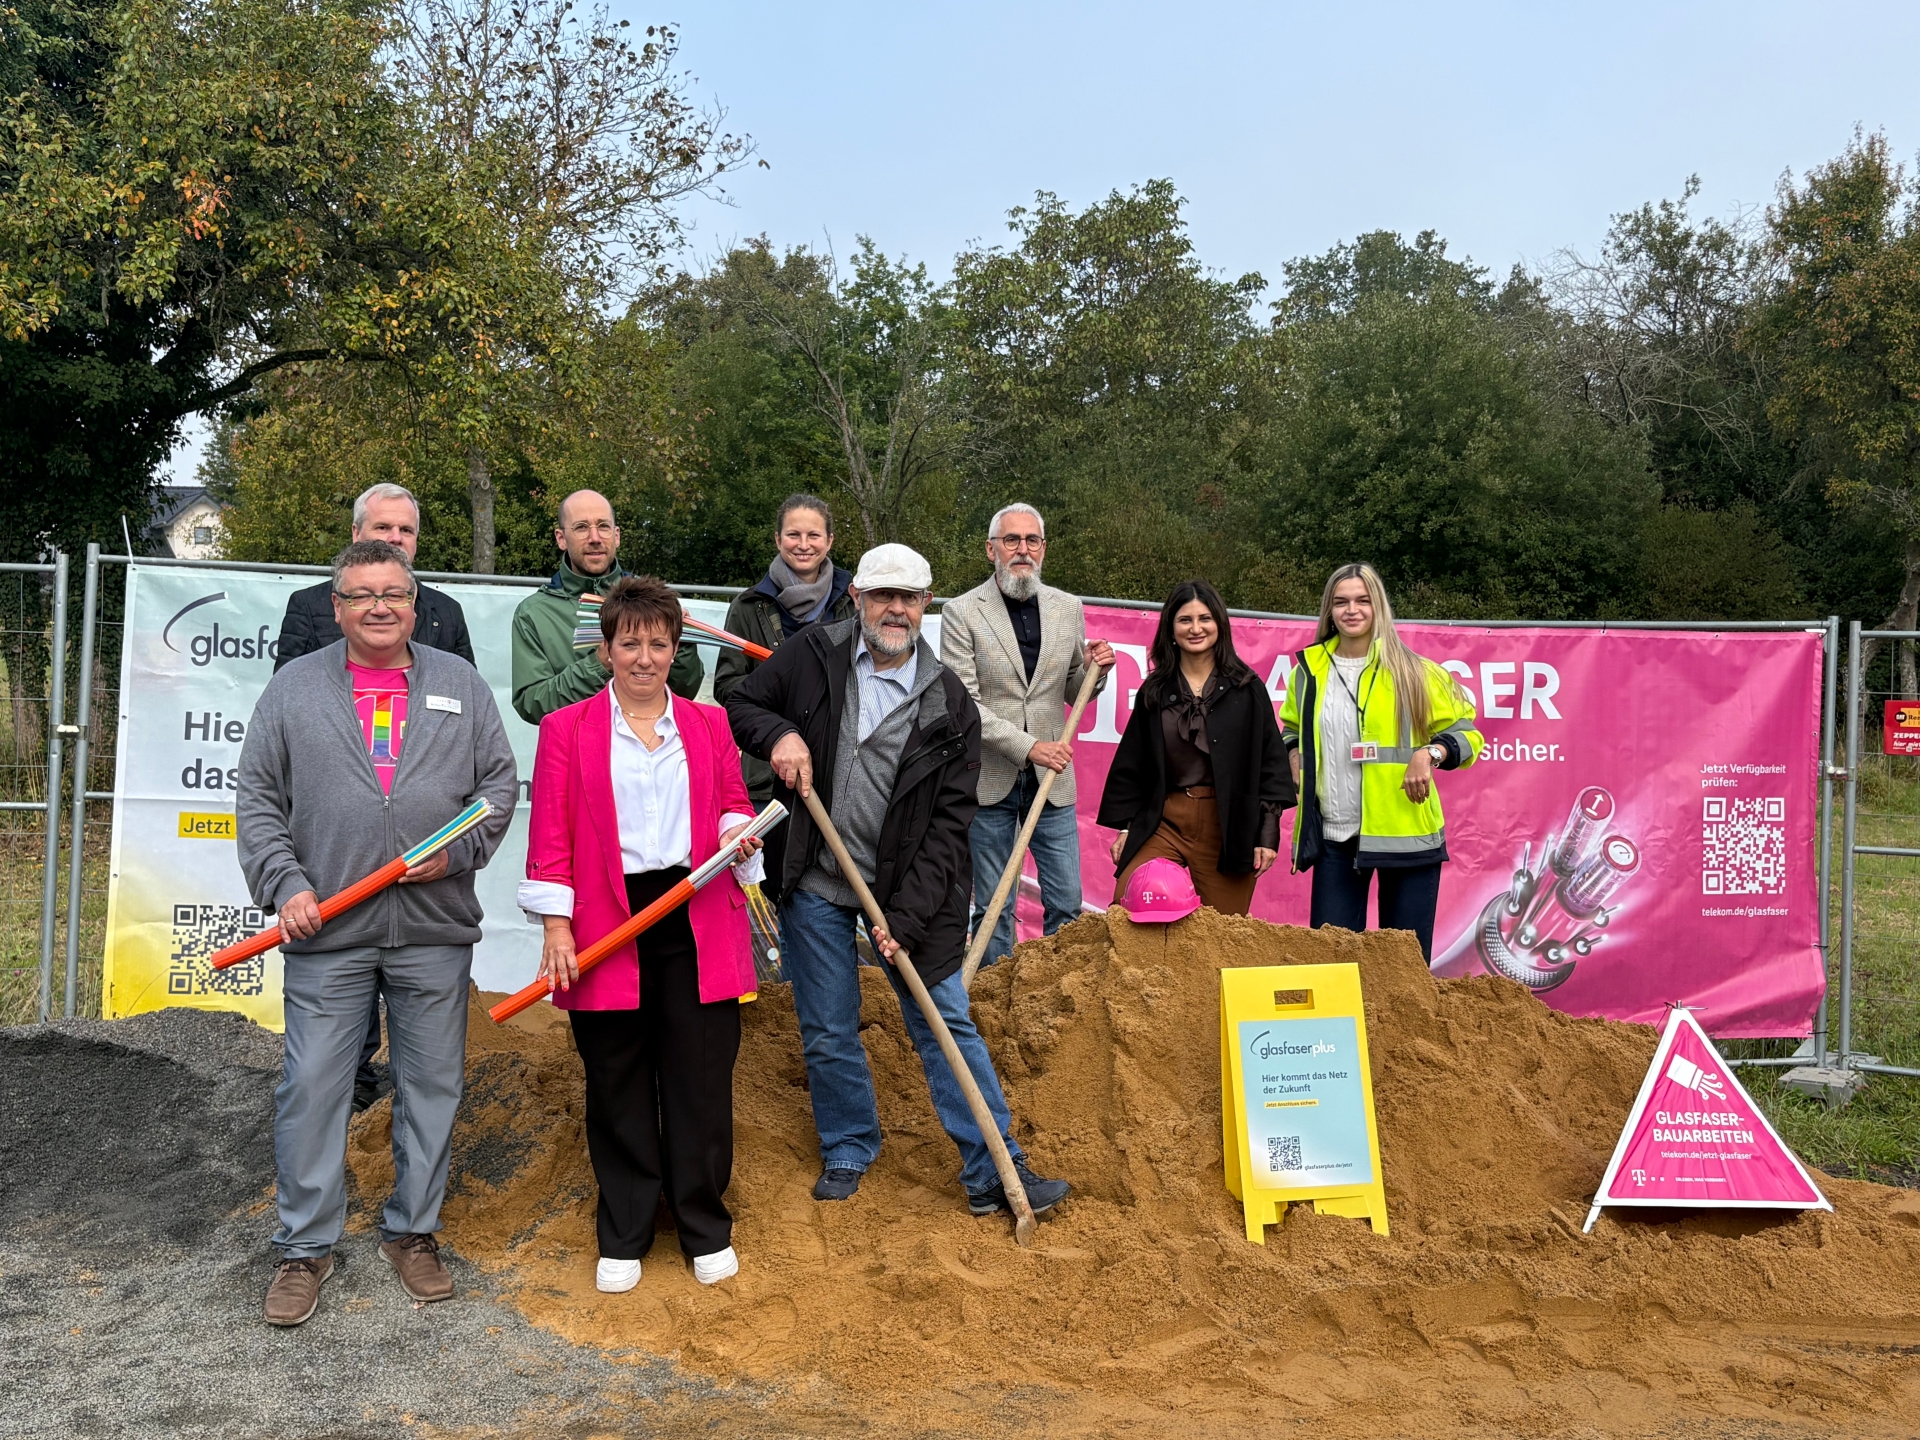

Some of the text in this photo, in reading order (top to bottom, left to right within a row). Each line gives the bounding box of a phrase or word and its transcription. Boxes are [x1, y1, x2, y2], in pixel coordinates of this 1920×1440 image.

[184, 711, 245, 743] Hie
[181, 758, 238, 791] das
[1700, 764, 1786, 776] Jetzt Verfügbarkeit
[1701, 777, 1738, 789] prüfen:
[183, 817, 231, 835] Jetzt
[1701, 906, 1789, 918] telekom.de/glasfaser
[1260, 1039, 1336, 1060] glasfaserplus
[1262, 1071, 1348, 1083] Hier kommt das Netz
[1263, 1084, 1311, 1094] der Zukunft
[1655, 1111, 1745, 1126] GLASFASER-
[1652, 1128, 1755, 1144] BAUARBEITEN
[1660, 1151, 1753, 1161] telekom.de/jetzt-glasfaser
